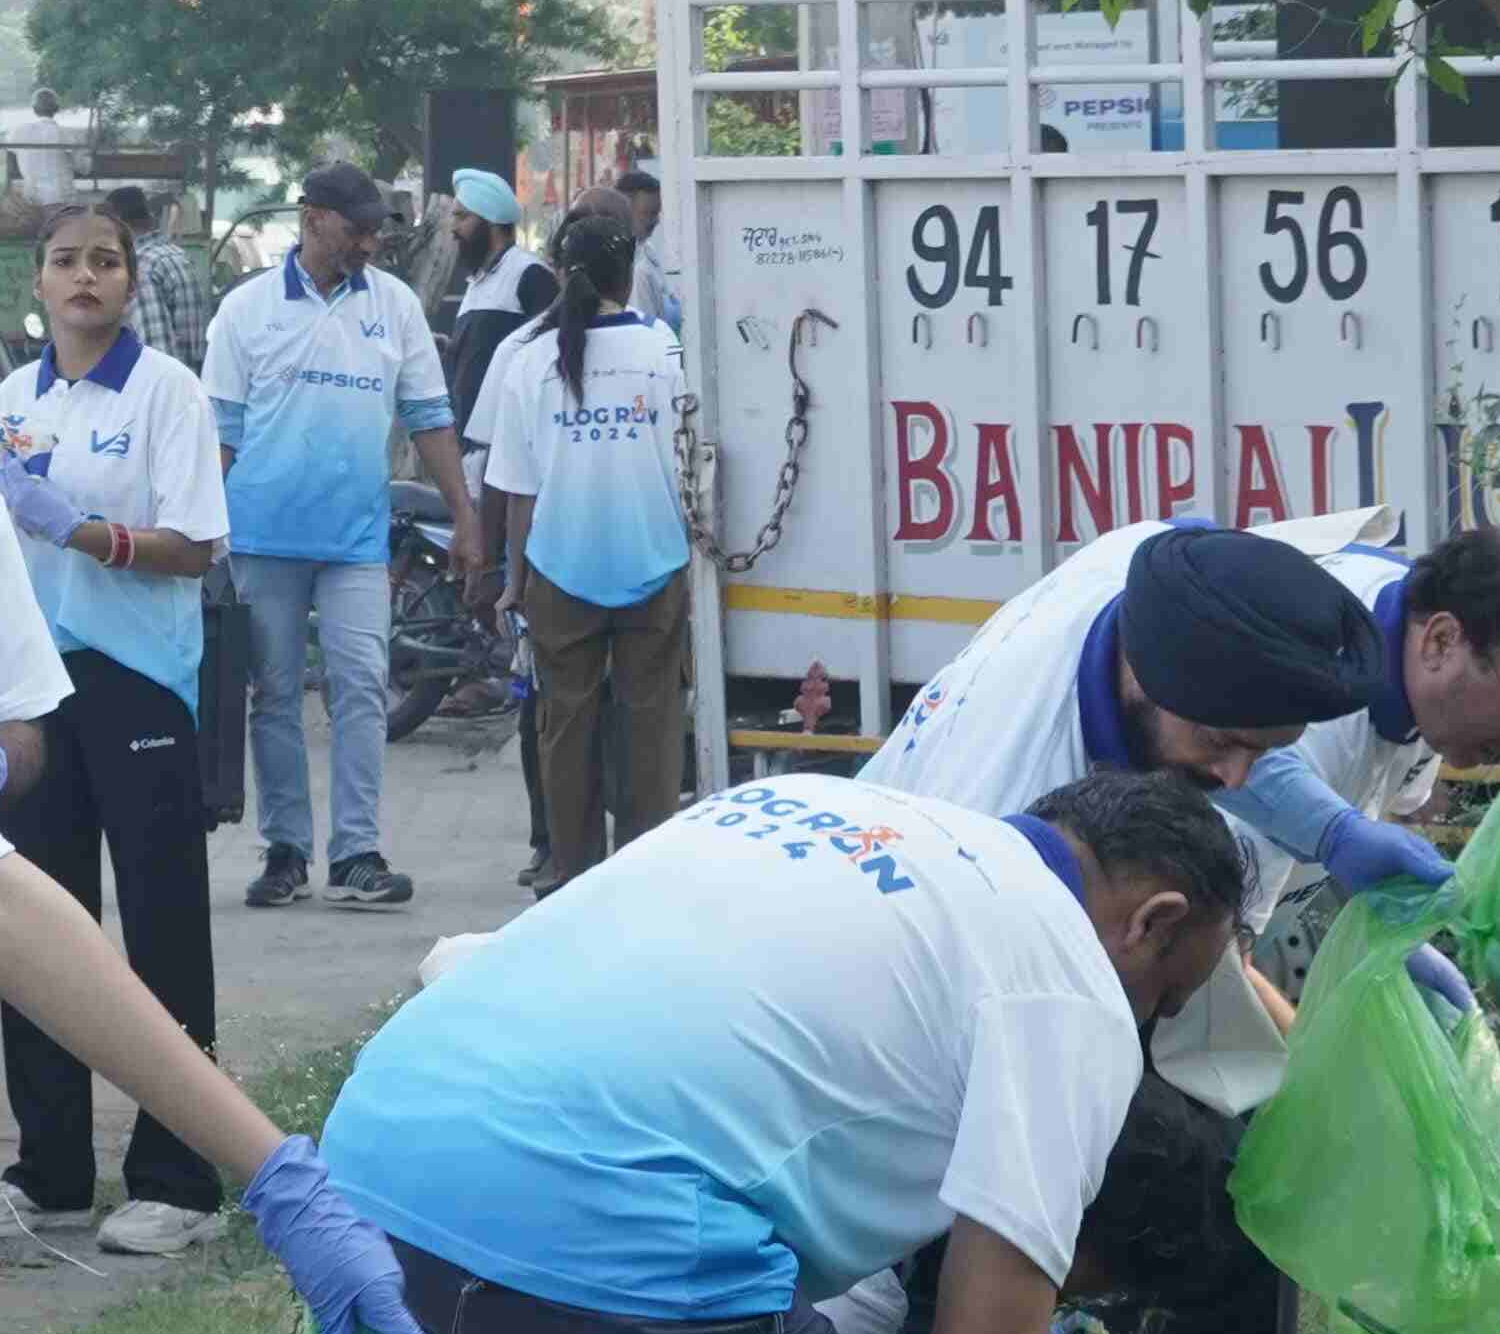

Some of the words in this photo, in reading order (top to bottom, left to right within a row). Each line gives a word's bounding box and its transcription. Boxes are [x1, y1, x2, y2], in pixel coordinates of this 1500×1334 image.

[906, 204, 1013, 309] 94
[1085, 199, 1163, 307] 17
[1258, 184, 1368, 304] 56
[571, 427, 639, 443] 2024
